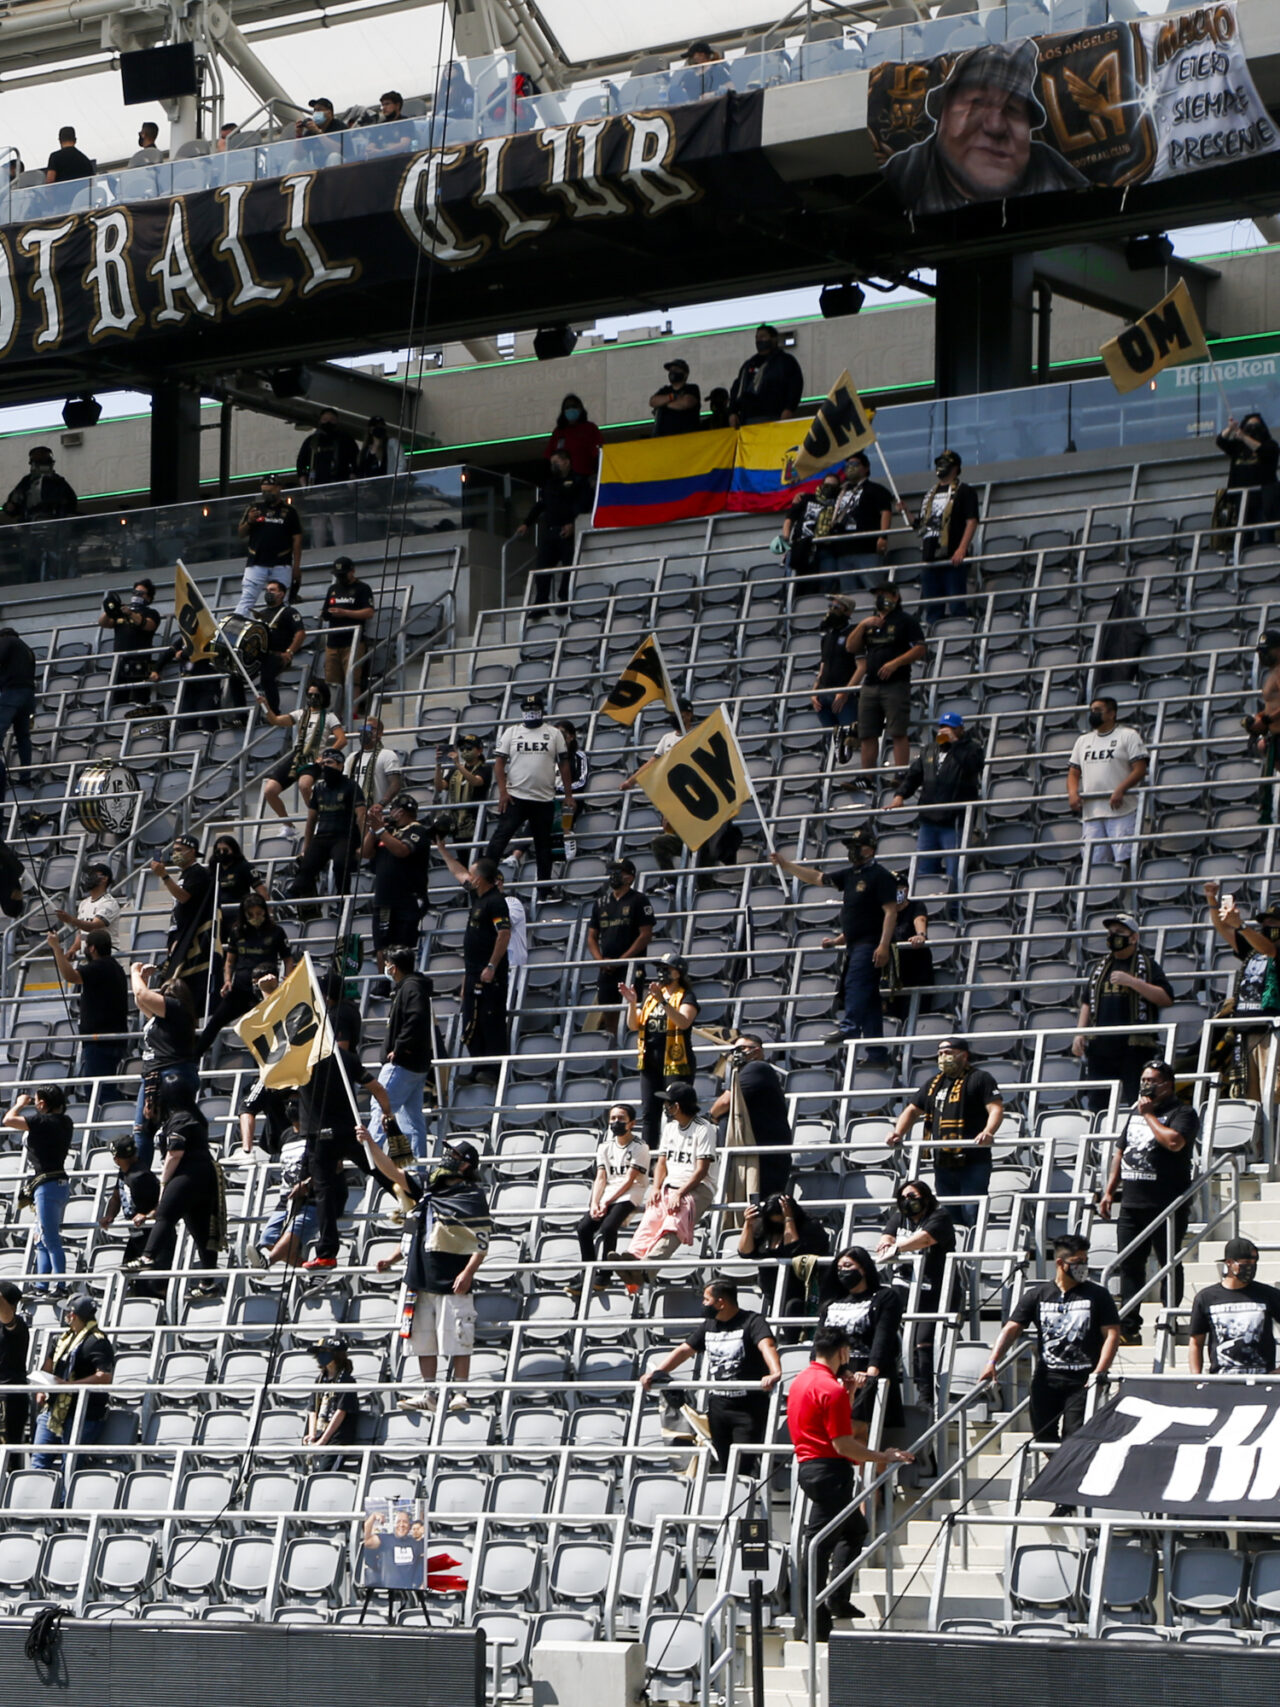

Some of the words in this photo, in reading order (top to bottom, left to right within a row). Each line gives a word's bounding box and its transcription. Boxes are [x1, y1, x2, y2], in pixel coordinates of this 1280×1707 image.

[1039, 47, 1062, 63] LOS
[1064, 30, 1118, 55] ANGELES
[1070, 151, 1110, 169] OOTBALL
[396, 113, 705, 265] CLUB
[1176, 359, 1276, 387] Heineken
[516, 742, 549, 752] FLEX
[1084, 749, 1116, 761] FLEX
[667, 1149, 693, 1164] FLEX
